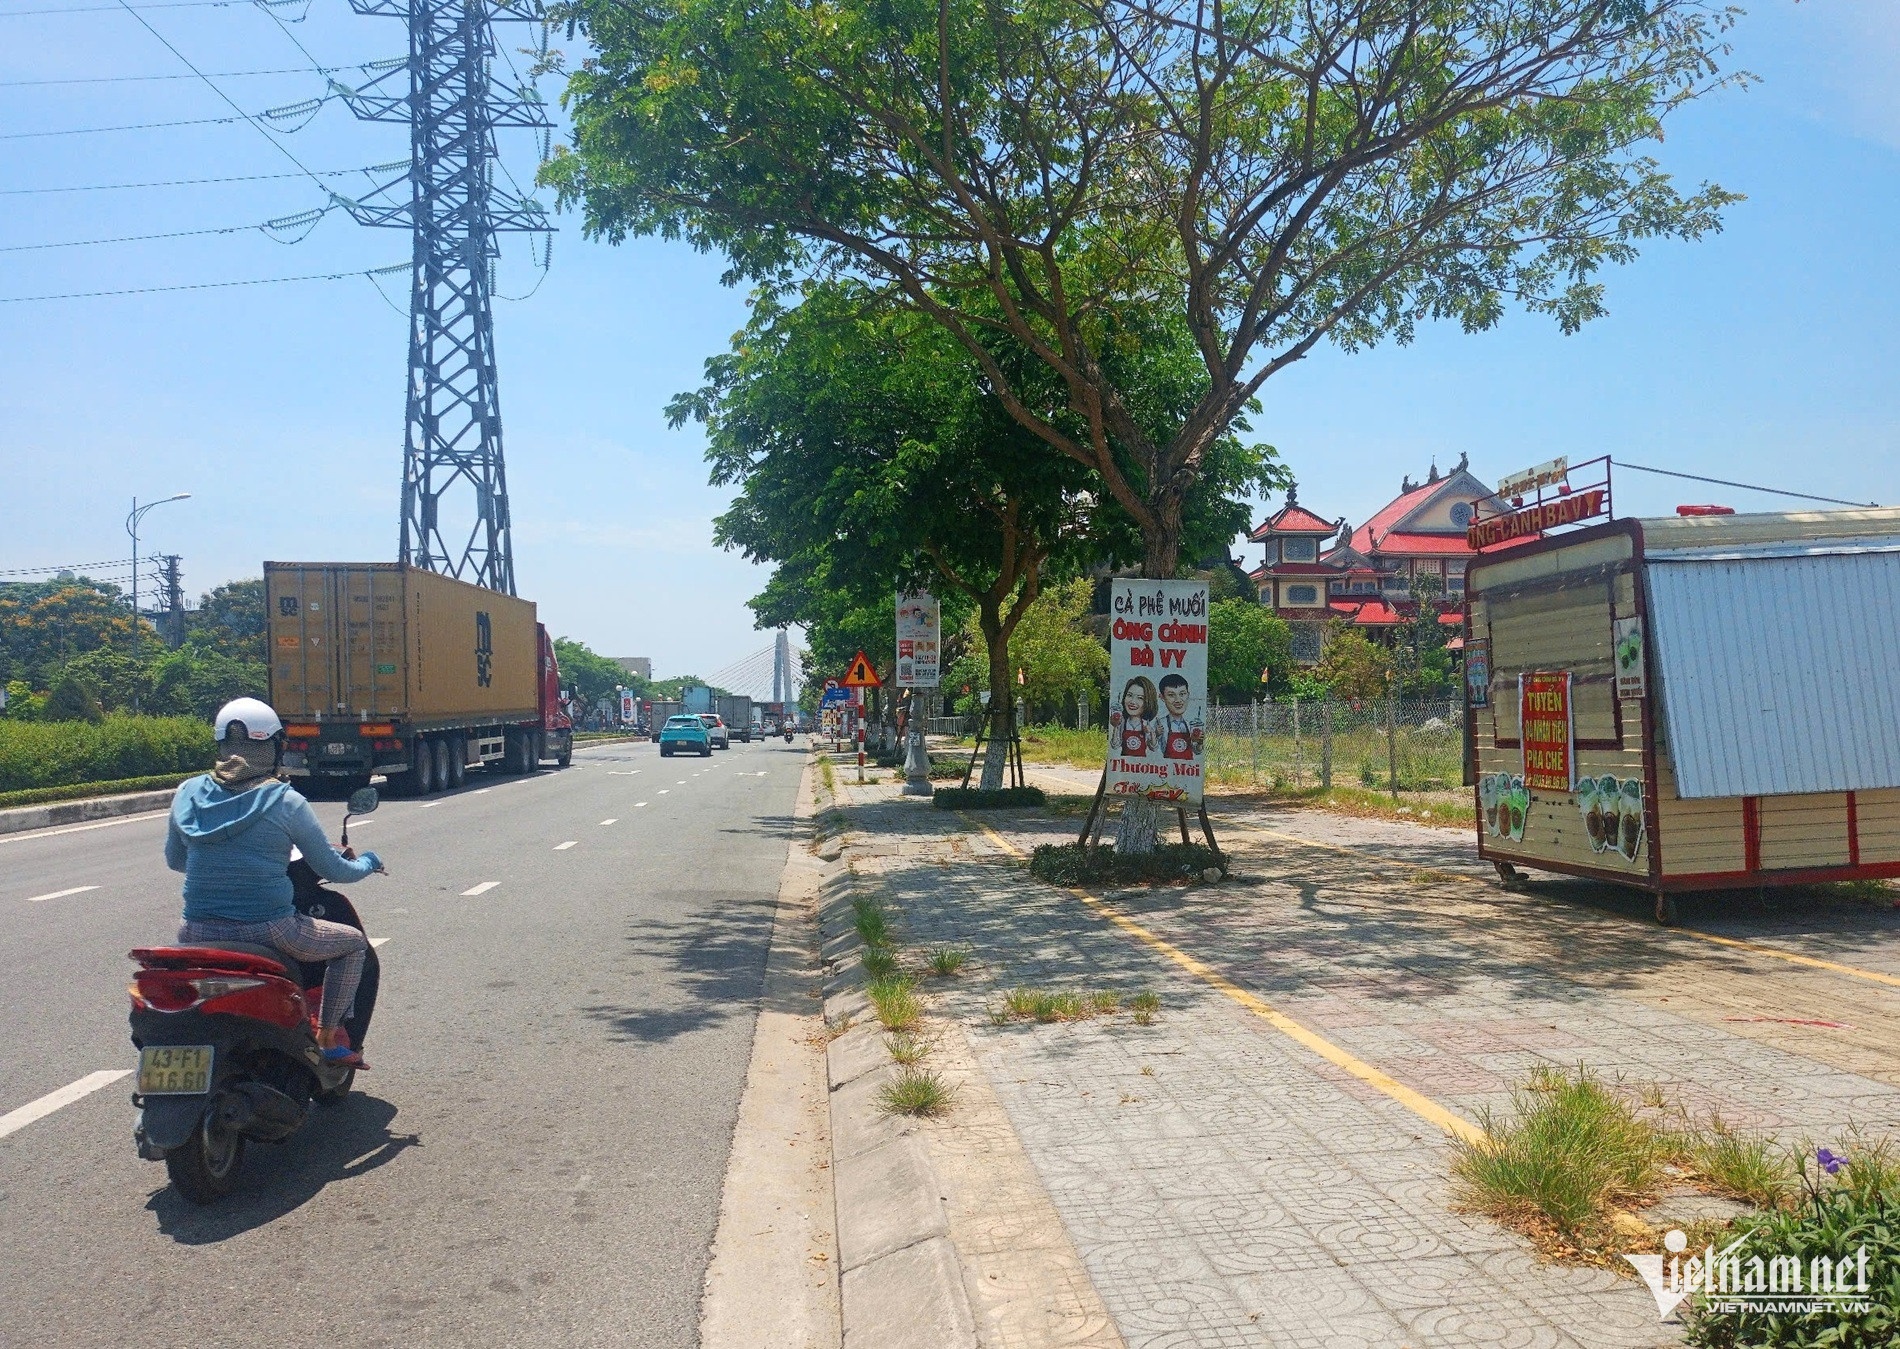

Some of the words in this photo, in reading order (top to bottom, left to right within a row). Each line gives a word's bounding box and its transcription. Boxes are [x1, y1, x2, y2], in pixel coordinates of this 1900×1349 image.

[1114, 589, 1134, 614] CÀ
[1139, 589, 1165, 617] PHÊ
[1169, 590, 1206, 617] MUỐI
[1112, 617, 1153, 641] ÔNG
[1157, 618, 1207, 644] CẢNH
[1130, 642, 1154, 667] BÀ
[1159, 648, 1187, 668] VY
[1527, 685, 1563, 712] TUYỂN
[1110, 759, 1168, 779] Thương
[1527, 750, 1543, 769] PHA
[1545, 746, 1564, 771] CHẾ
[151, 1048, 201, 1068] 43-F1
